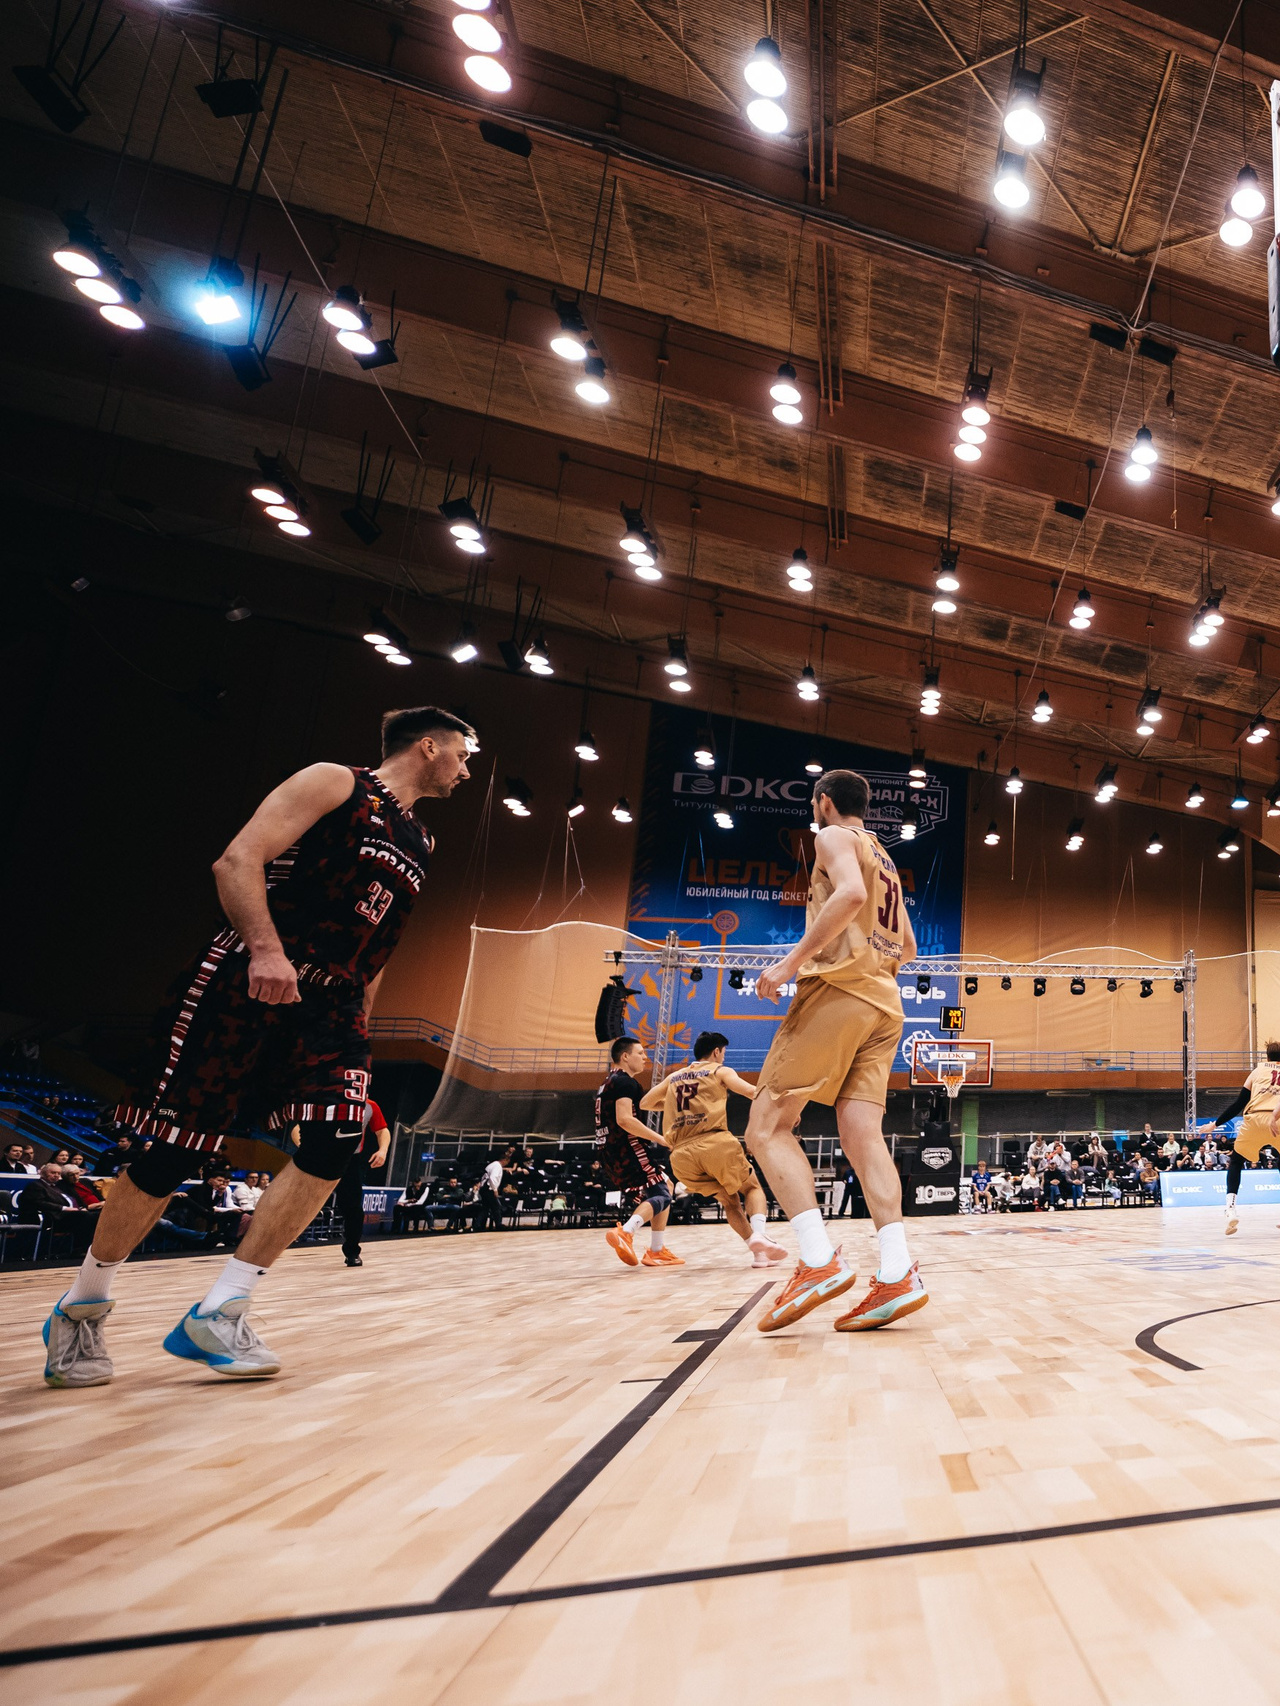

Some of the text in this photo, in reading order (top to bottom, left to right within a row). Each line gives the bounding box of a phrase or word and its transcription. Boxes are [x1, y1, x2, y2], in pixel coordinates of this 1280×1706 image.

[720, 775, 808, 801] DKC
[750, 805, 808, 816] спонсор
[355, 880, 394, 925] 33
[686, 886, 808, 901] ЮБИЛЕЙНЫЙ ГОД БАСКЕТ
[878, 870, 899, 933] 31
[950, 1016, 962, 1028] 14
[344, 1069, 371, 1102] 3
